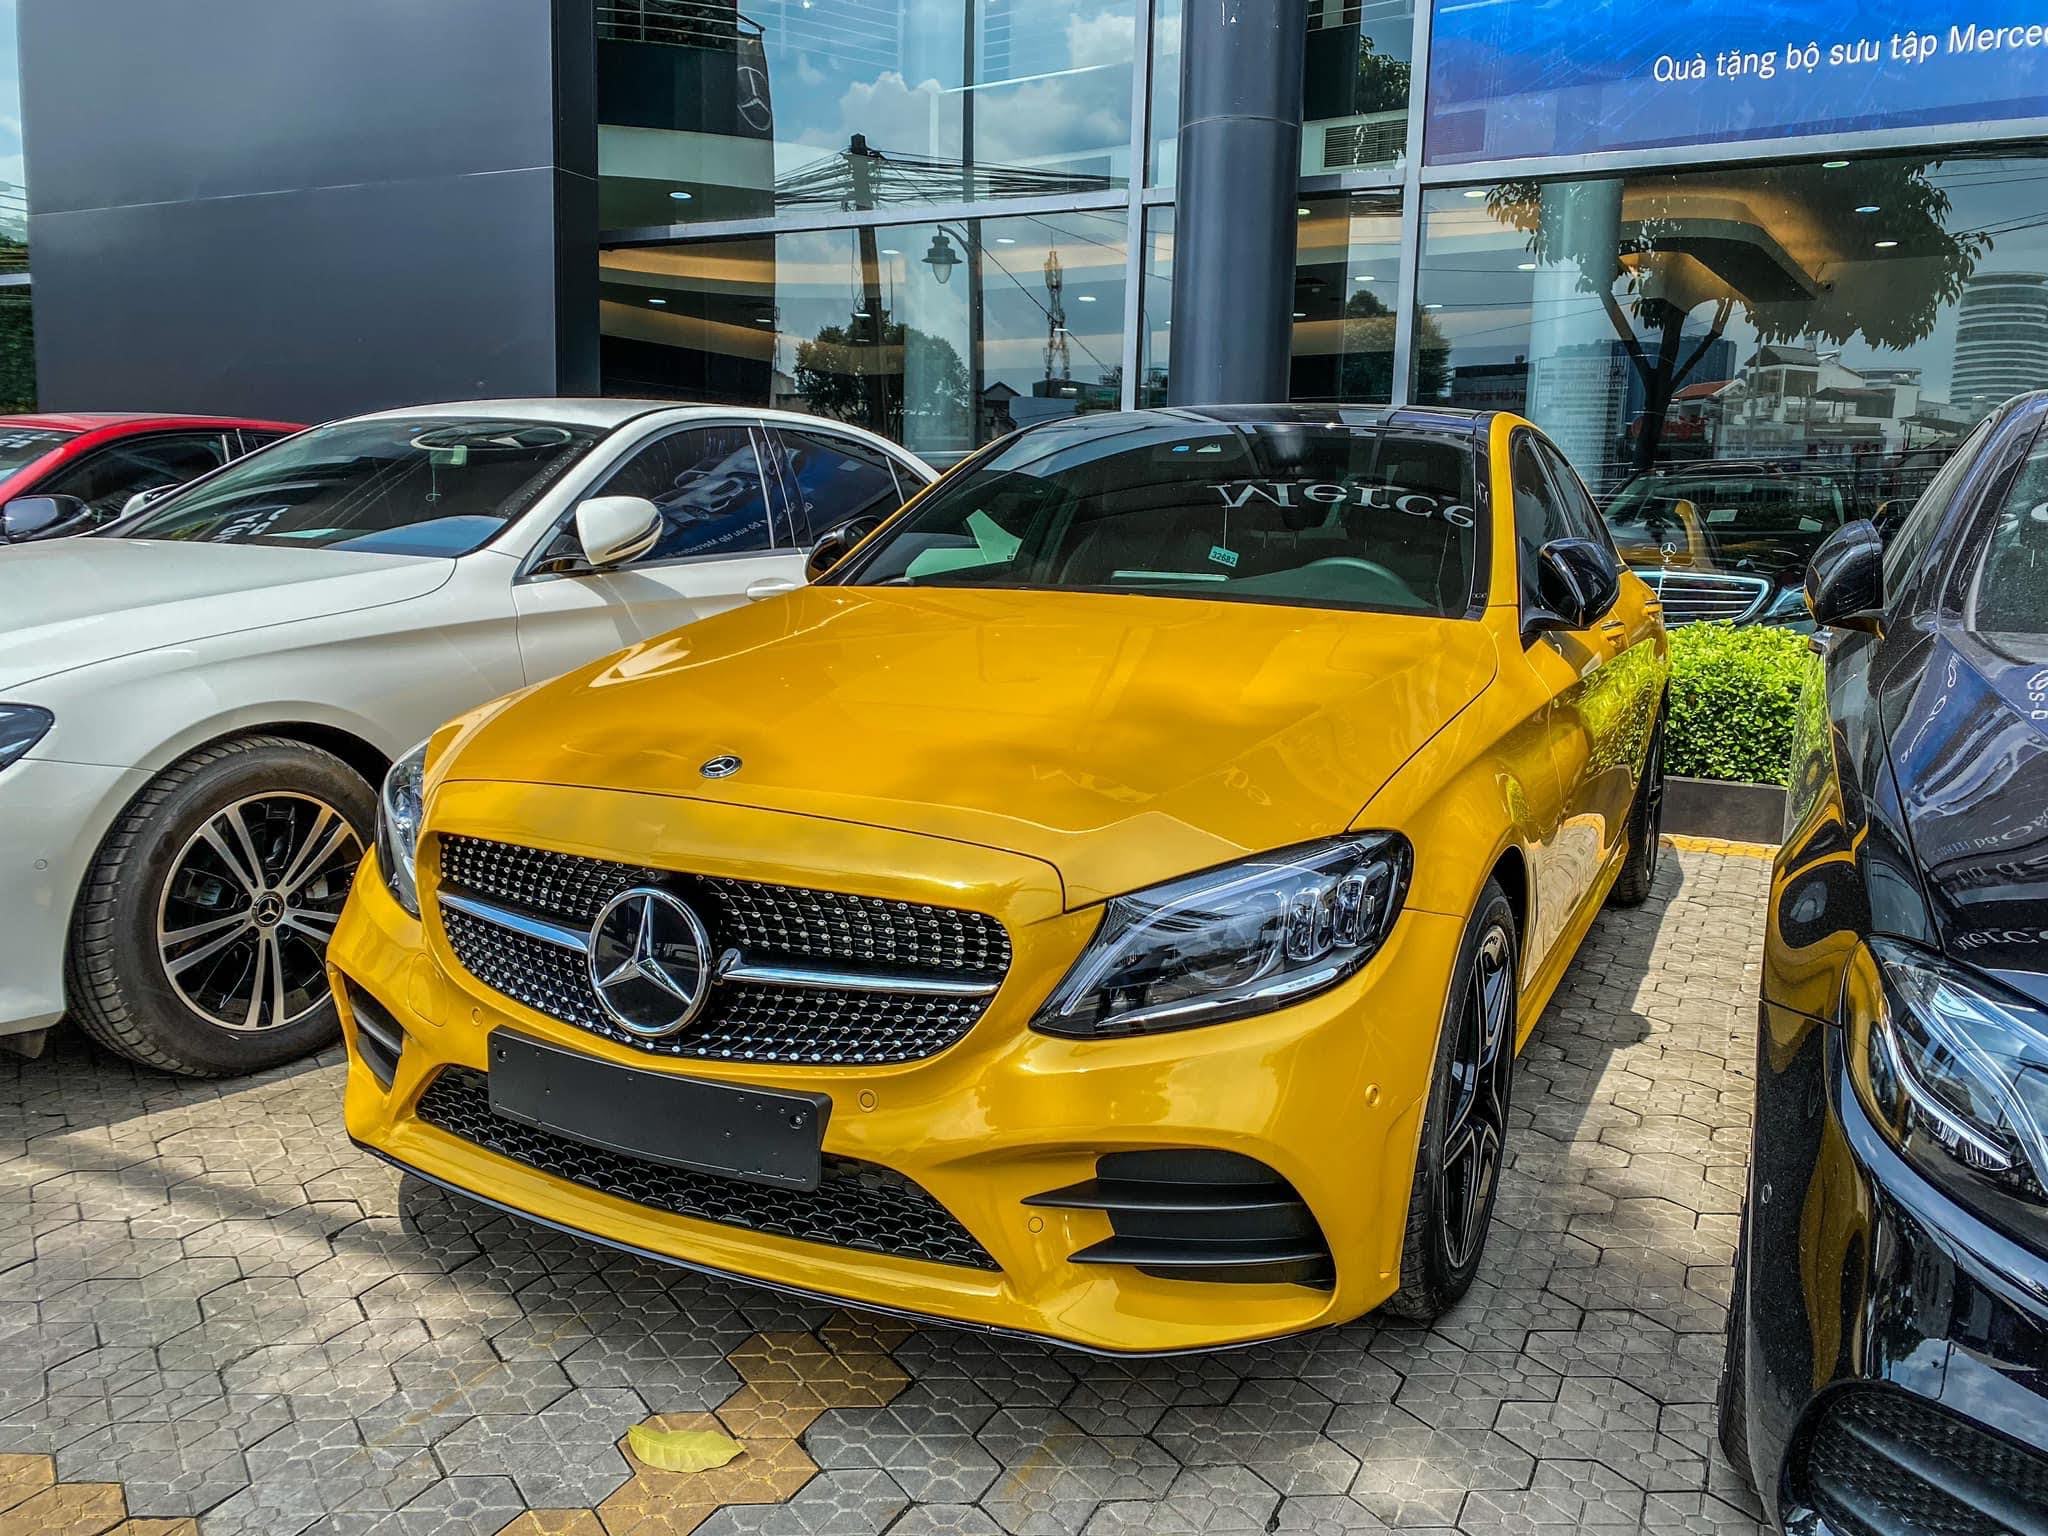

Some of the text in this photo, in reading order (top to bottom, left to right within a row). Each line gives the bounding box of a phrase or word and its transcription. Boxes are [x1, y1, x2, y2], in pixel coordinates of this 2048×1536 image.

[1653, 52, 1707, 82] Quà
[1715, 49, 1777, 82] tặng
[1785, 41, 1821, 74] bộ
[1829, 38, 1880, 66] sưu
[1890, 30, 1938, 64] tập
